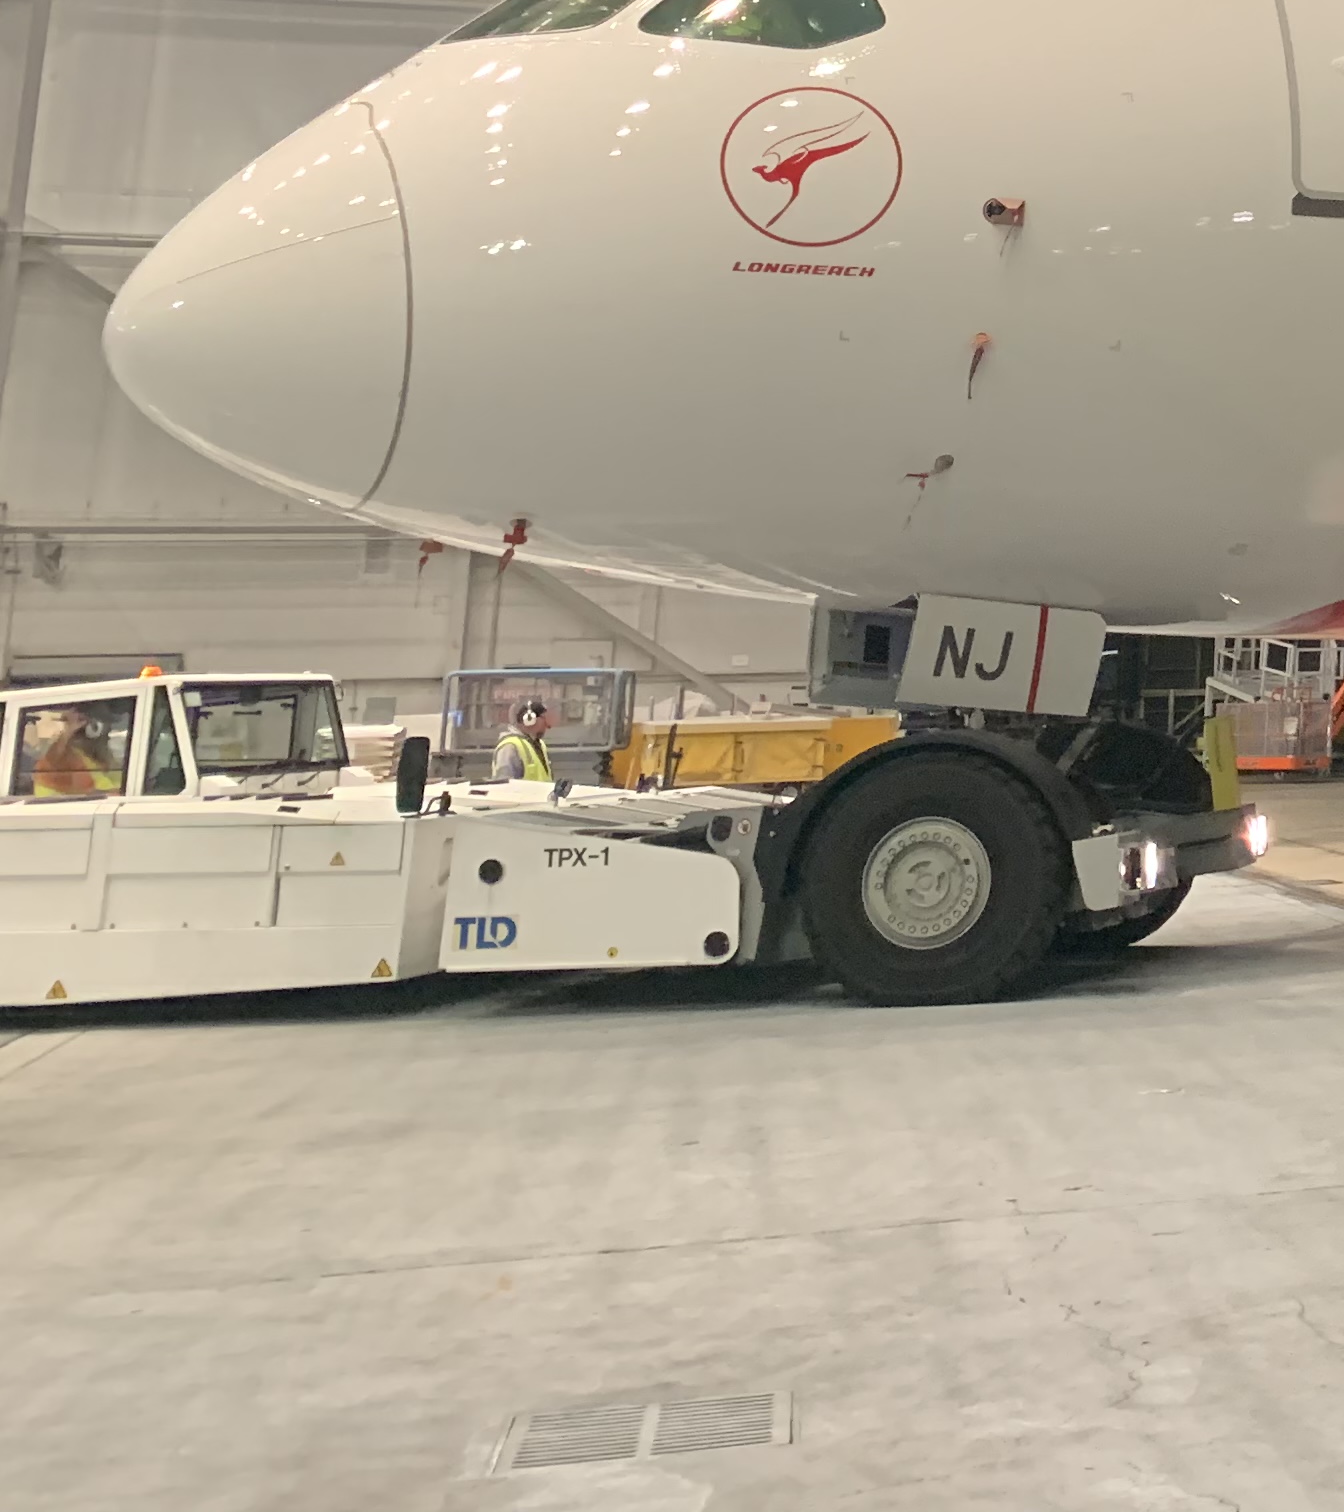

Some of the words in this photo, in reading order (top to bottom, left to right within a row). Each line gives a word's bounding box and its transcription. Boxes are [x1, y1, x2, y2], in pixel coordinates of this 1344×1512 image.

[732, 261, 875, 277] LONGREACH
[932, 625, 1014, 681] NJ
[544, 847, 609, 867] TPX-1
[454, 916, 517, 950] TLD
